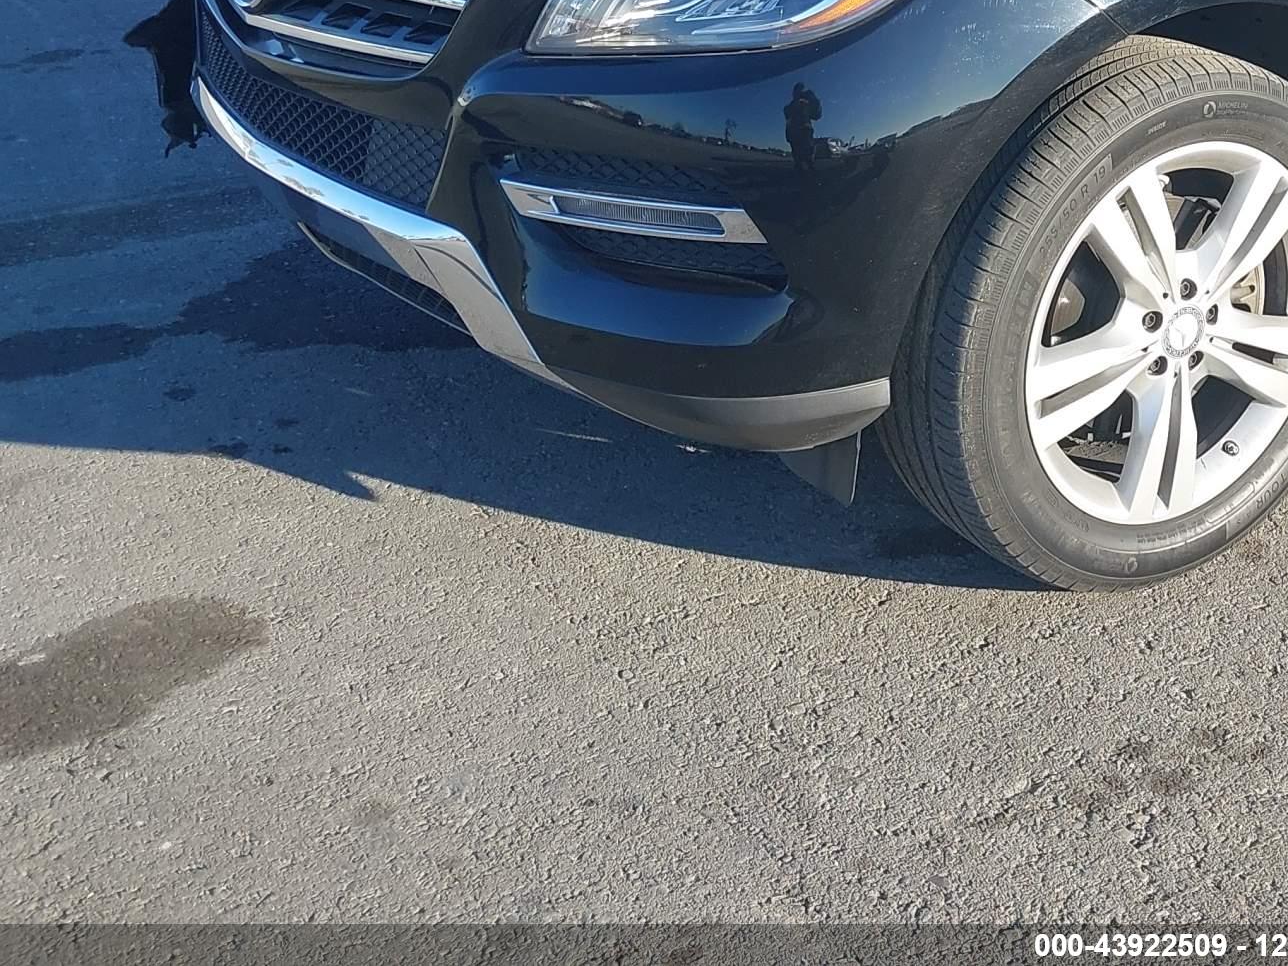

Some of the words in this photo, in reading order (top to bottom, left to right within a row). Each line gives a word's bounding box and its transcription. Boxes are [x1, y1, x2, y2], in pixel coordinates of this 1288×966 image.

[1081, 183, 1090, 198] R
[1093, 165, 1107, 184] 19
[1256, 473, 1288, 510] TOUR
